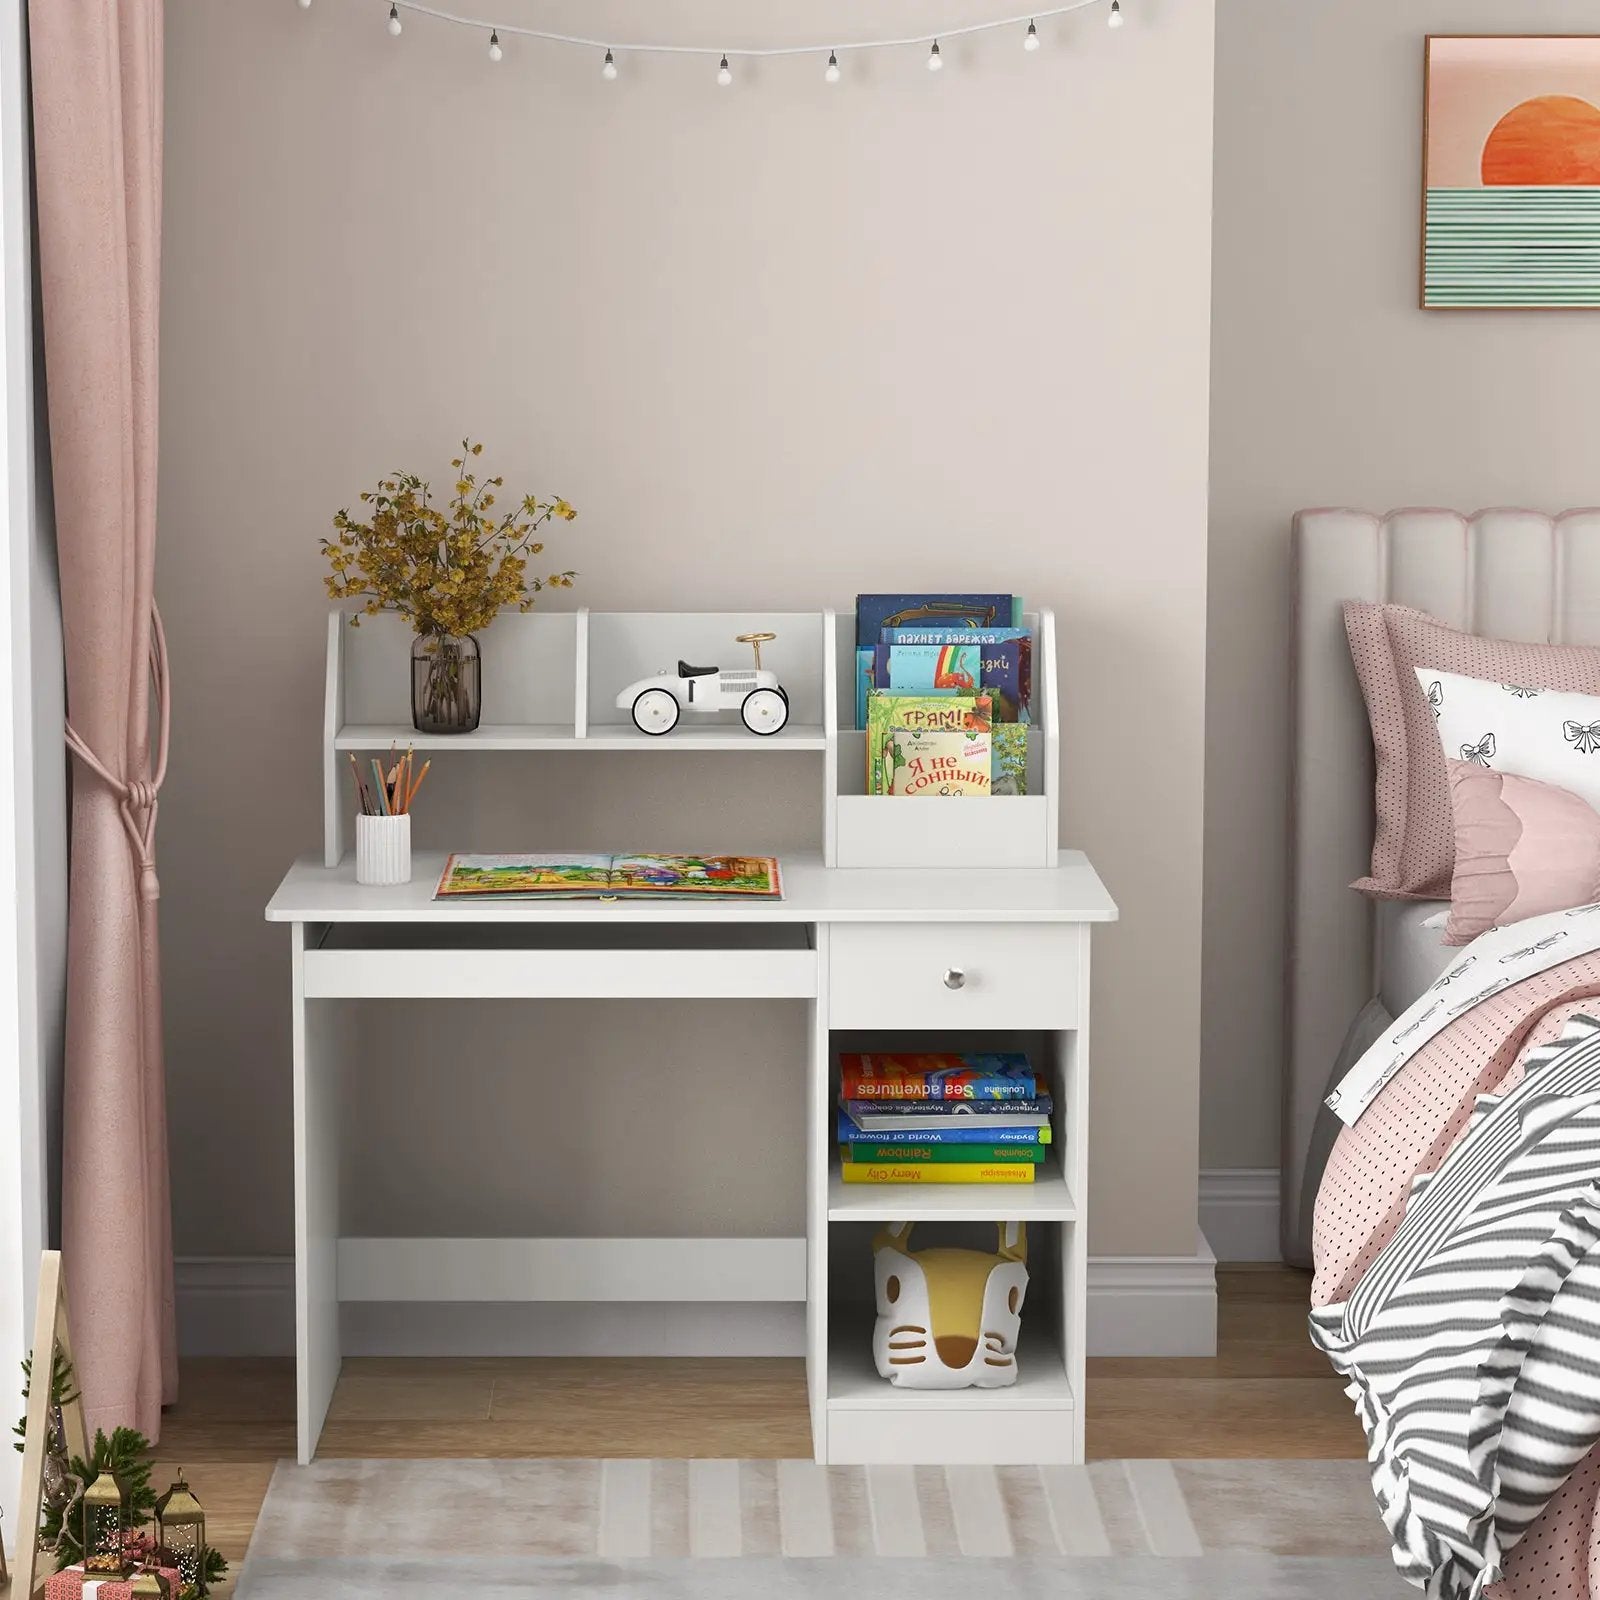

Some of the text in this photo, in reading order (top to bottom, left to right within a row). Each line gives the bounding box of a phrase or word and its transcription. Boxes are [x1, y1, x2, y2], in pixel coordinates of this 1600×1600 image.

[980, 659, 1009, 673] азки
[903, 709, 961, 726] ТРЯМ!
[908, 756, 957, 778] Я не
[904, 768, 990, 795] сонный!
[858, 1084, 1025, 1097] Louisiana Sea adventures
[849, 1133, 1035, 1141] Sydney World of flowers
[877, 1148, 1034, 1159] Columbia Rainbow
[867, 1167, 1027, 1179] Mississippi Merry City
